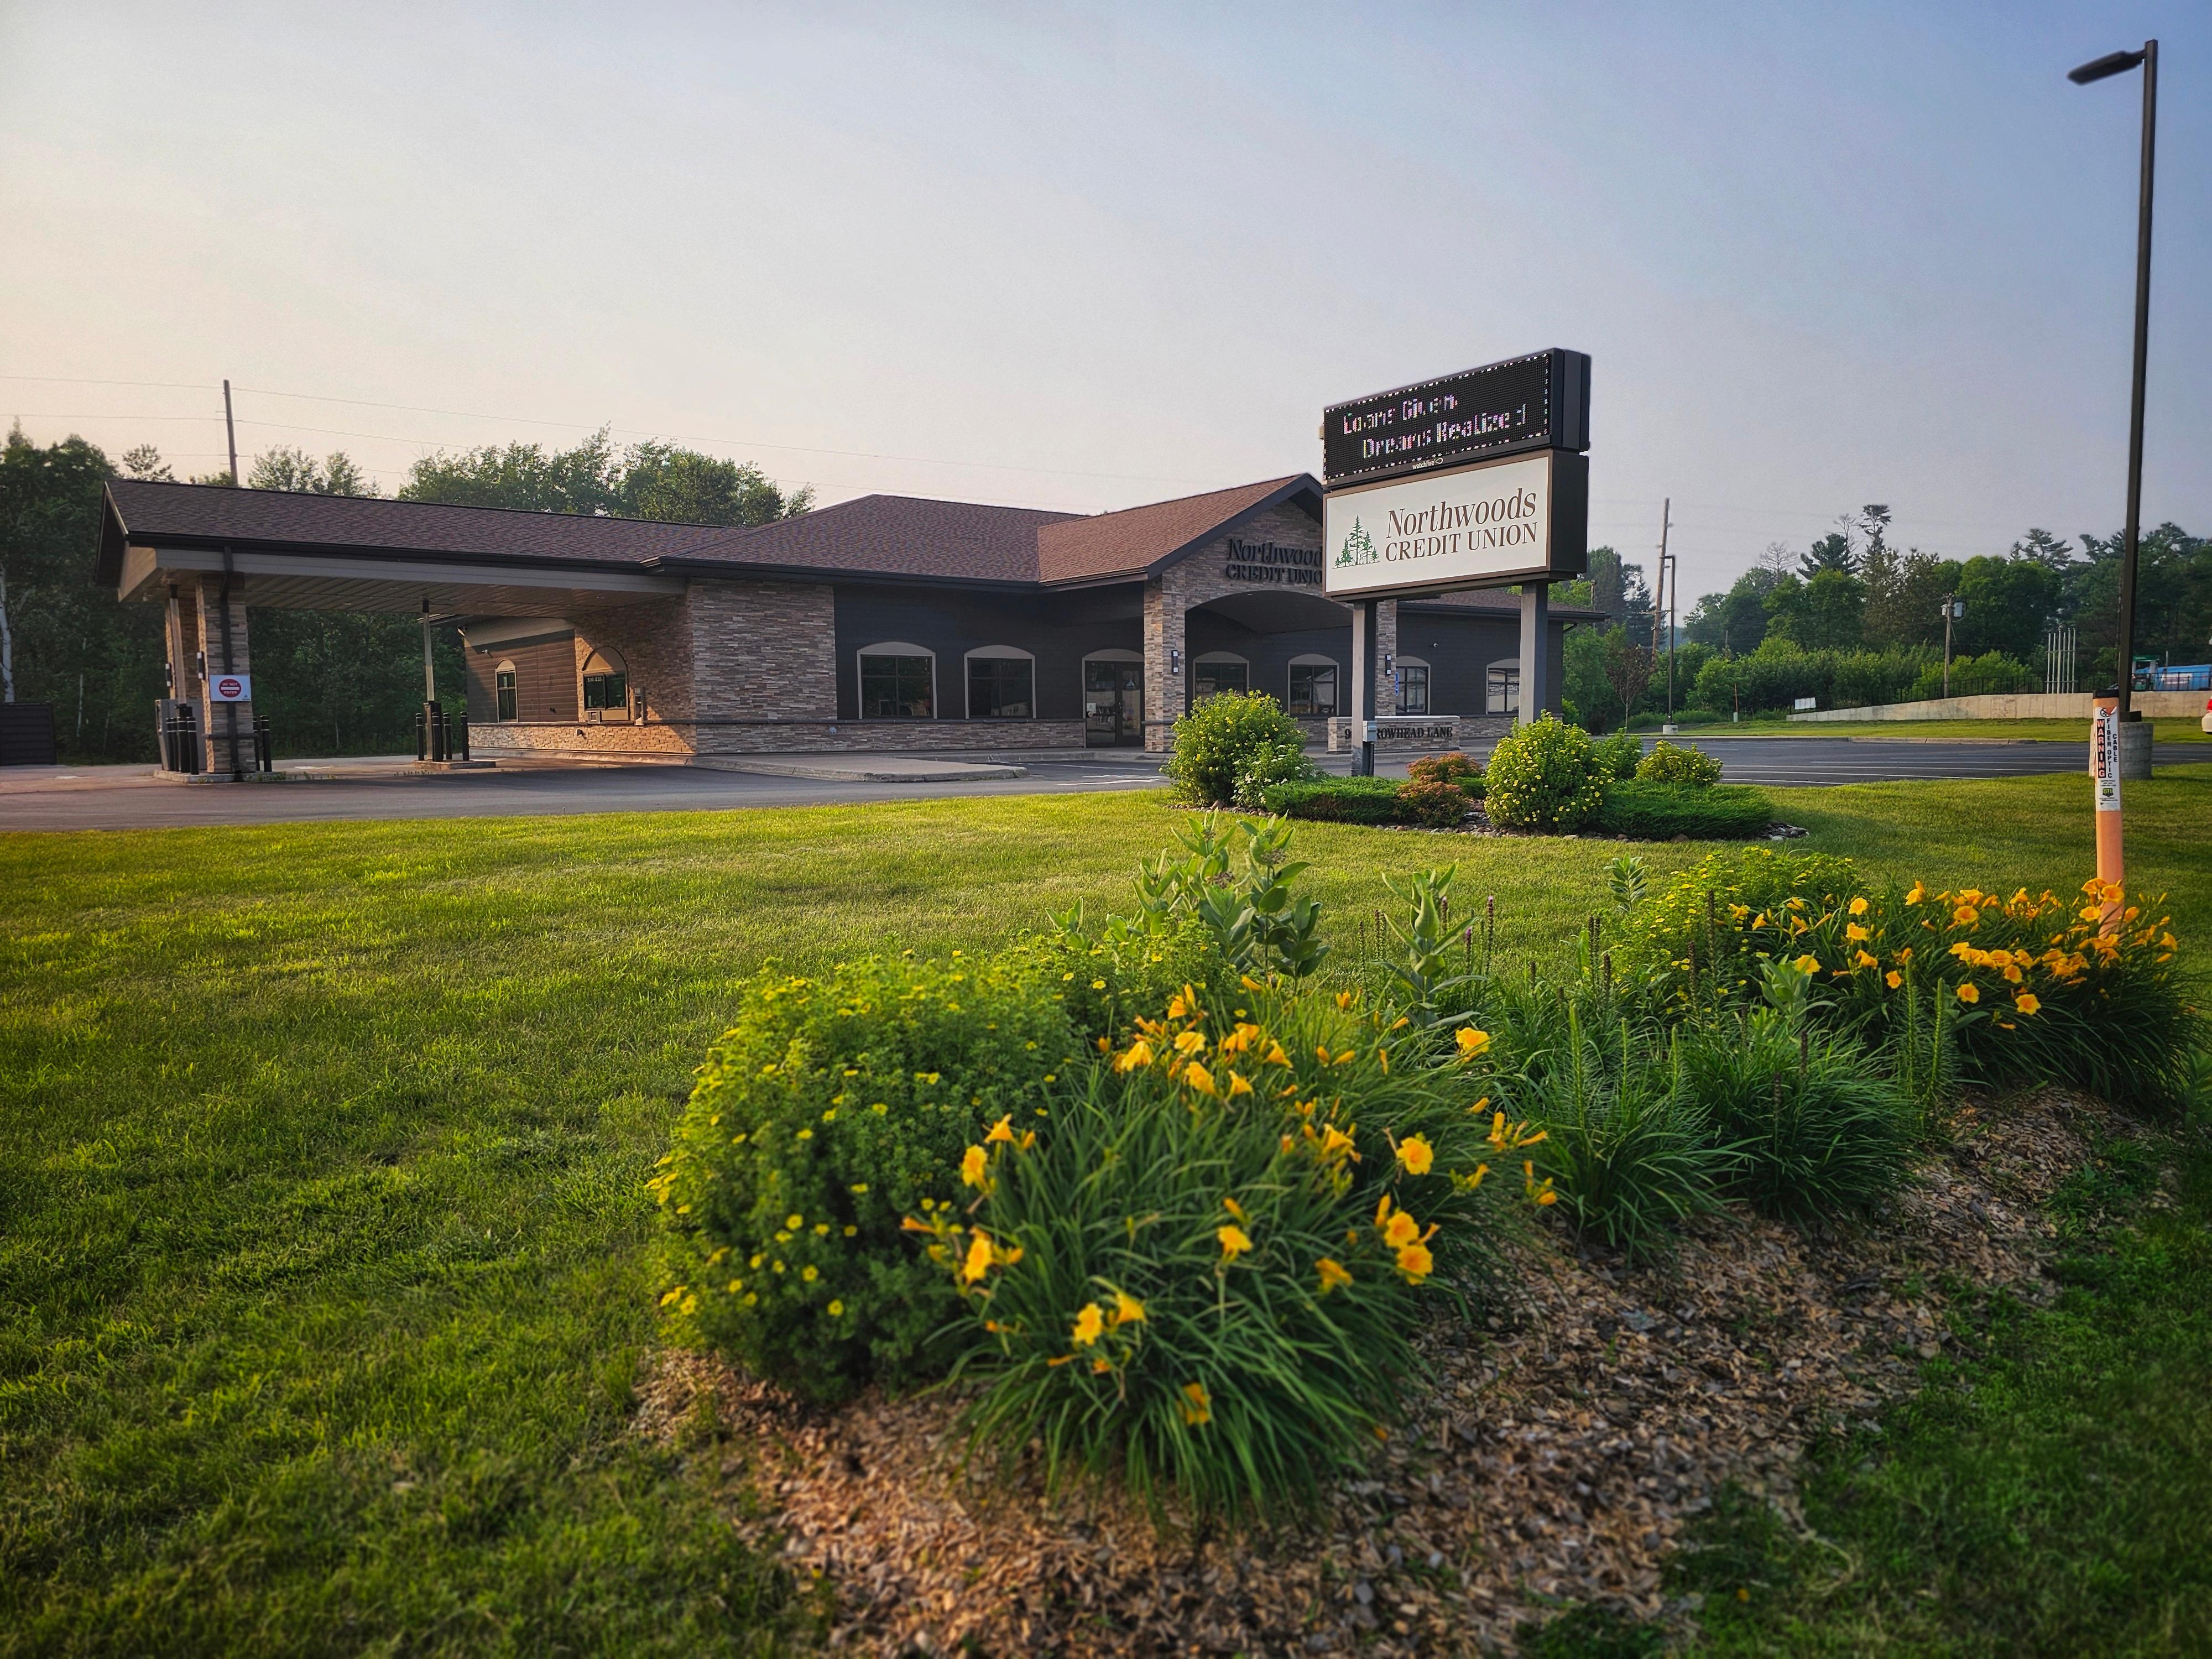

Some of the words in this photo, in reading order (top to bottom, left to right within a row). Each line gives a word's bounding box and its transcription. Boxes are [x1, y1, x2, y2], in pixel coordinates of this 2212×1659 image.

[1363, 430, 1432, 459] Dreams
[1412, 460, 1435, 469] watchfire
[1386, 487, 1536, 539] Northwoods
[1227, 538, 1322, 566] Northwood
[1385, 533, 1461, 562] CREDIT
[1468, 521, 1538, 551] UNION
[1225, 564, 1285, 581] CREDIT
[1287, 568, 1322, 585] UNIO
[1377, 728, 1423, 739] ROWHEAD
[1427, 727, 1453, 738] LANE
[2097, 719, 2105, 778] WARNING
